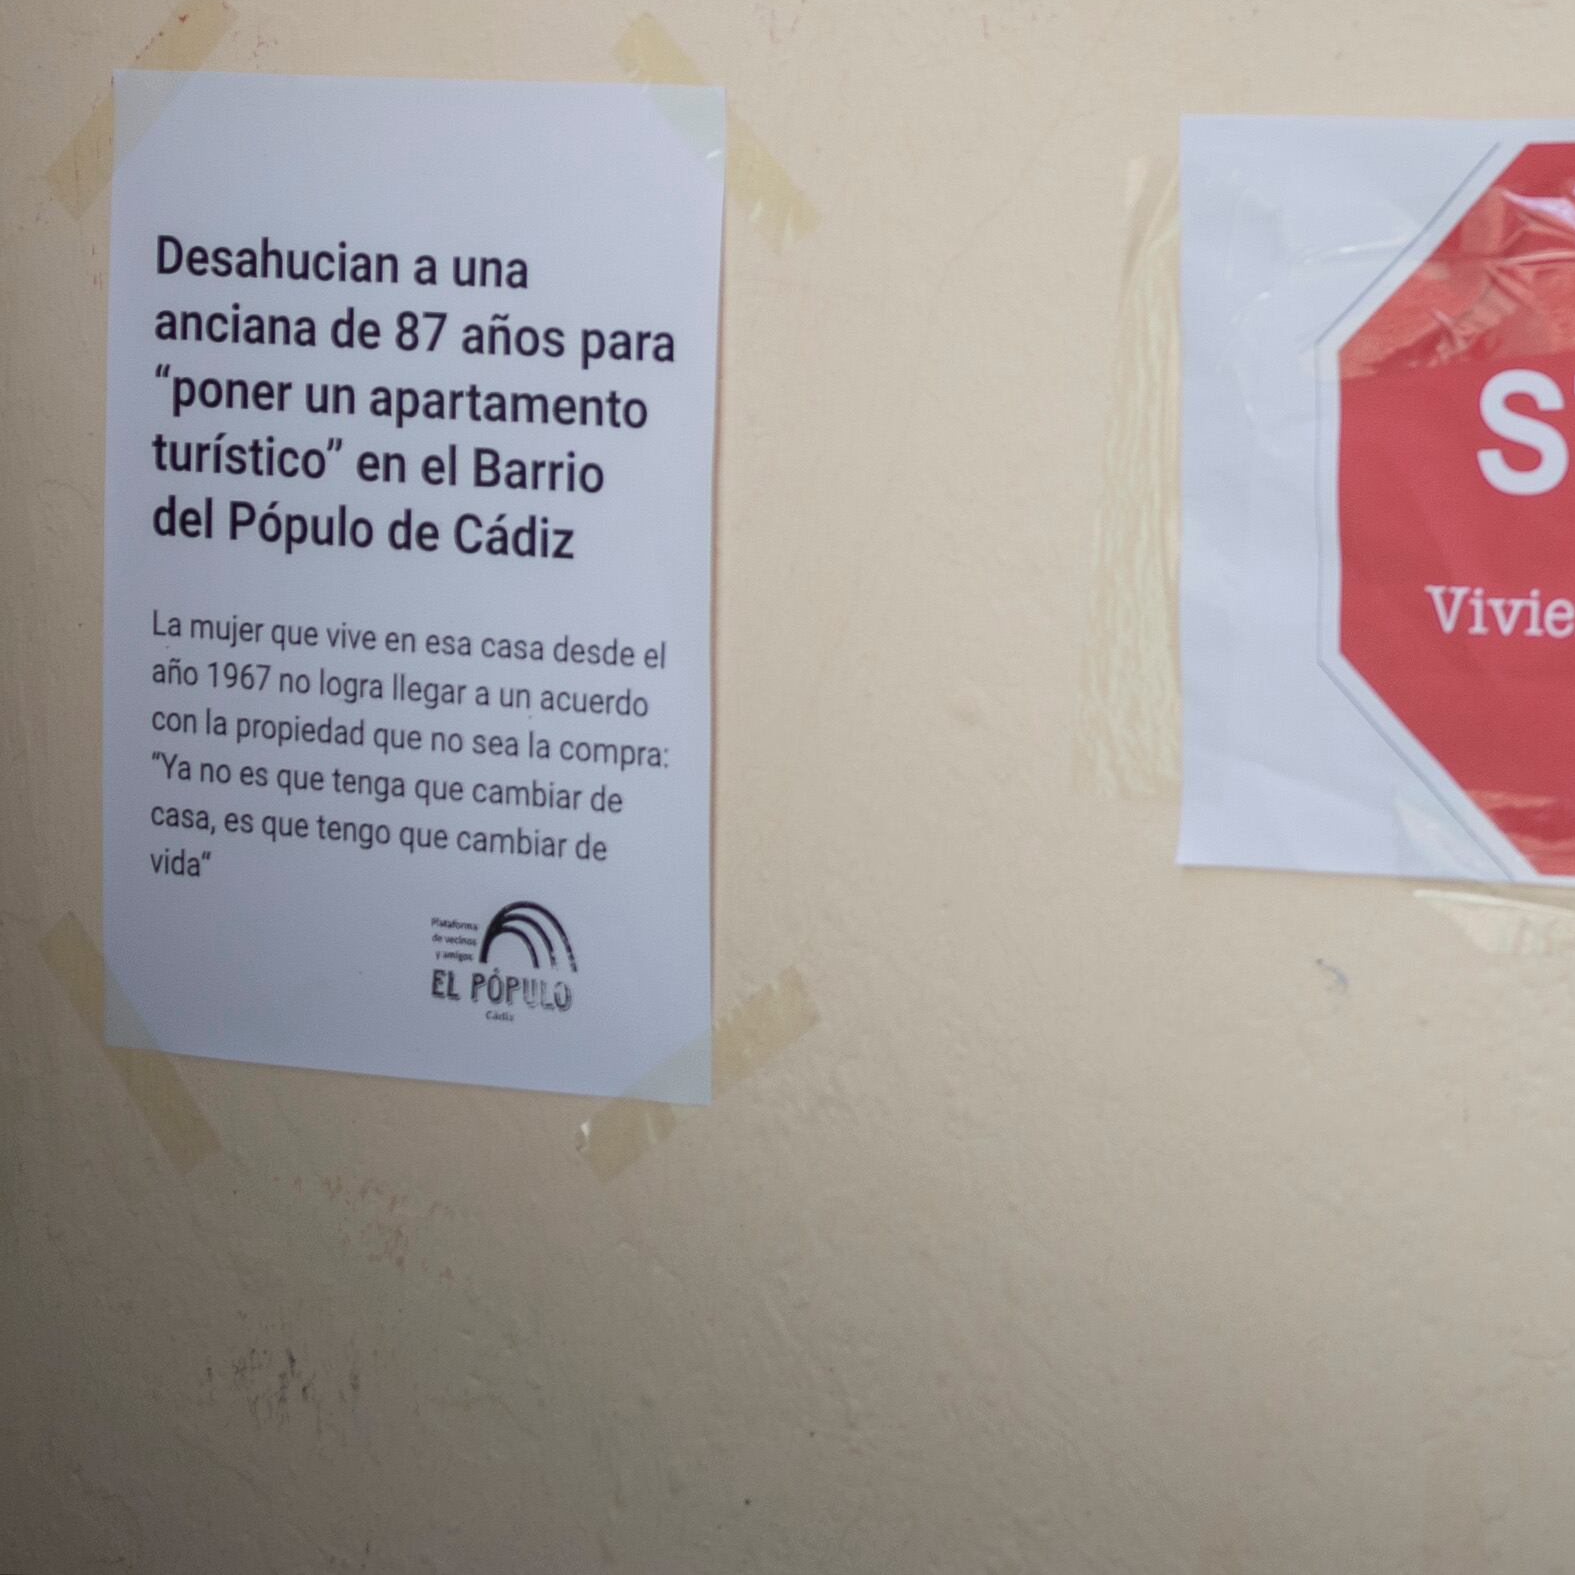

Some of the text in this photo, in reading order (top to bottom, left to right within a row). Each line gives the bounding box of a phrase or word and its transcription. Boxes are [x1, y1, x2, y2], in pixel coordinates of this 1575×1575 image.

[156, 234, 529, 290] Desahucian a una
[154, 301, 676, 371] anciana de 87 años para
[305, 382, 356, 416] un
[368, 383, 649, 430] apartamento
[355, 450, 407, 484] en
[420, 443, 457, 487] el
[473, 446, 605, 495] Barrio
[152, 494, 575, 561] del Pópulo de Cádiz
[152, 608, 667, 670] La mujer que vive en esa casa desde el
[151, 657, 649, 718] año 1967 no logra llegar a un acuerdo
[151, 707, 669, 773] con la propiedad que no sea la compra:
[199, 762, 232, 785] no
[239, 765, 269, 788] es
[276, 768, 325, 797] que
[331, 767, 406, 804] tenga
[414, 778, 465, 807] que
[471, 779, 583, 811] cambiar
[589, 784, 624, 814] de
[150, 805, 608, 862] casa, es que tengo que cambiar de
[431, 917, 479, 932] Plataforma
[432, 934, 478, 947] de vecinos
[443, 952, 474, 963] amigos
[432, 967, 573, 1012] EL PÓPULO
[485, 1010, 515, 1022] Cádiz
